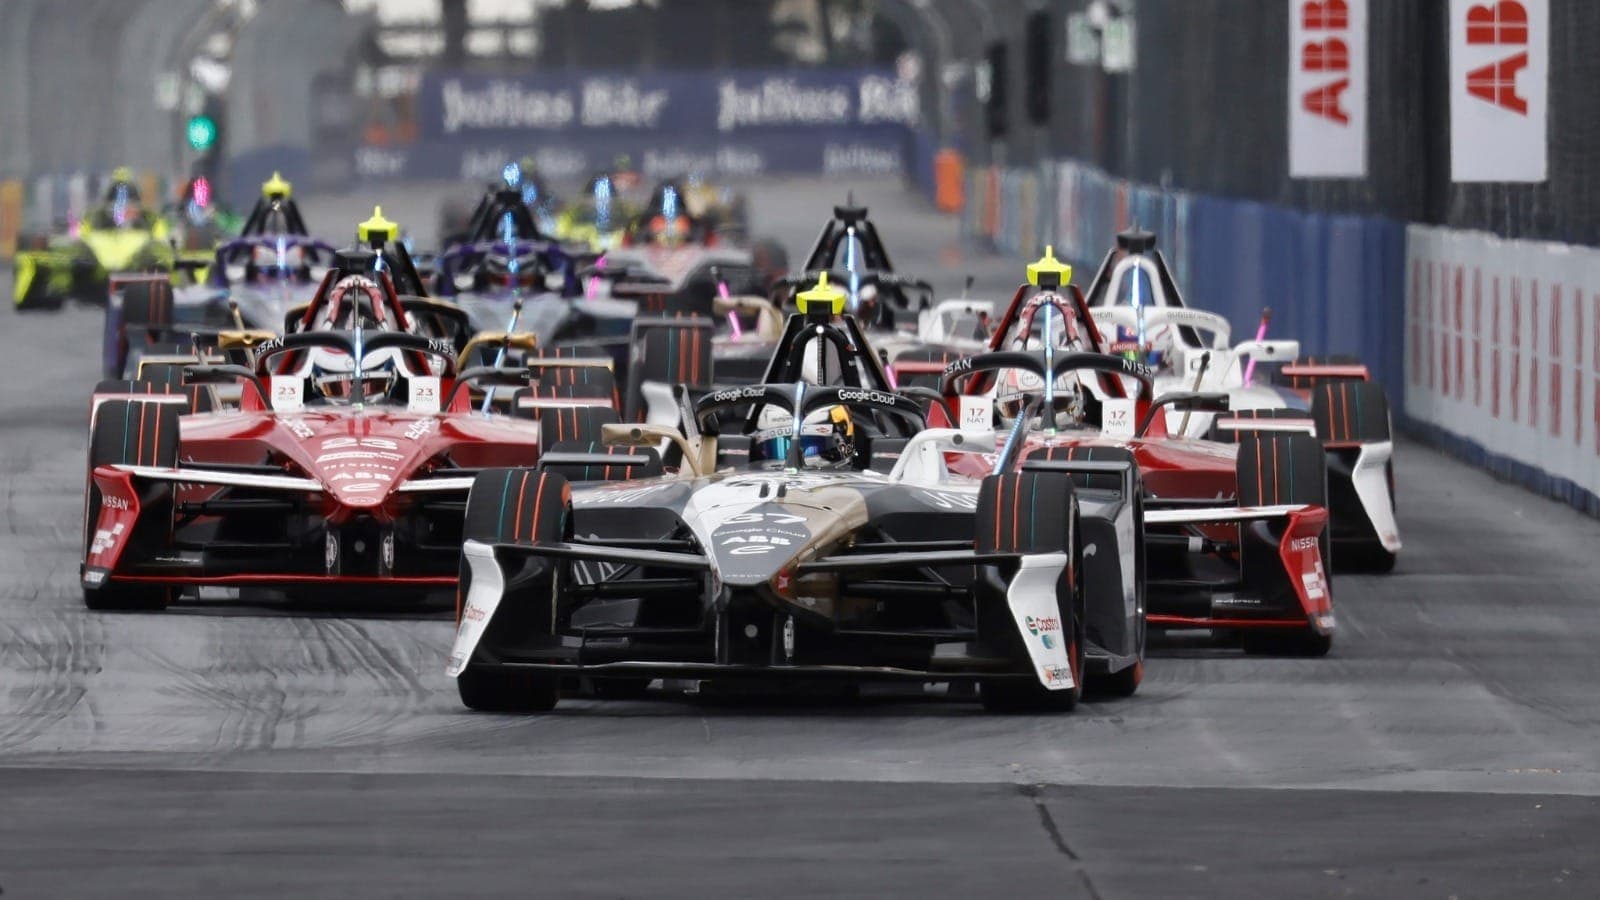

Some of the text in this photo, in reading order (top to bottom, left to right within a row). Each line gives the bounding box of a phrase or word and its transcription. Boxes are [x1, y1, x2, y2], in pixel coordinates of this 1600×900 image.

[1303, 0, 1349, 127] ABB
[1122, 359, 1153, 377] NISS
[278, 386, 296, 395] 23
[416, 387, 434, 396] 23
[838, 389, 895, 405] Google Cloud
[969, 408, 985, 417] 17
[1110, 410, 1126, 419] 17
